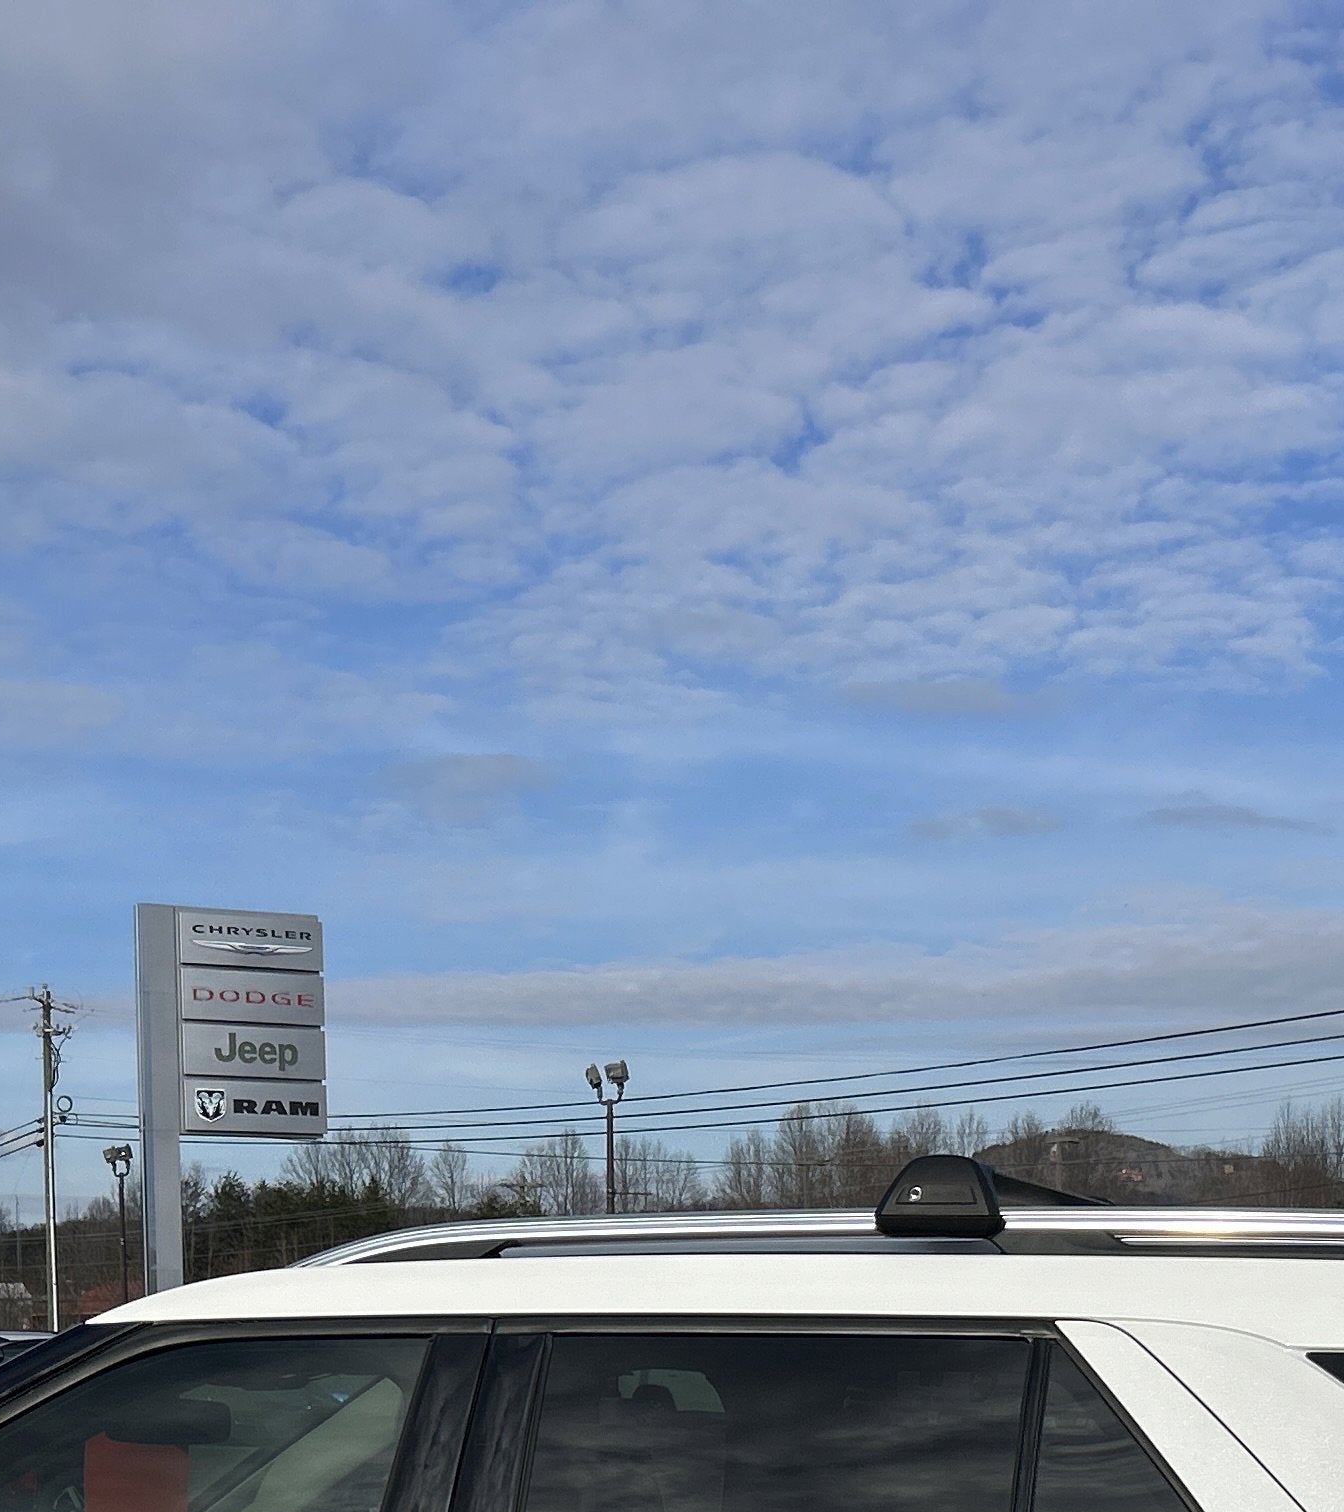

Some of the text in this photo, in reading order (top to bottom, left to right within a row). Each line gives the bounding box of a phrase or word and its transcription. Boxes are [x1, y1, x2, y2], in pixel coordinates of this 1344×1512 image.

[192, 924, 312, 941] CHRYSLER
[192, 988, 315, 1008] DODGE
[214, 1032, 298, 1071] Jeep
[233, 1099, 320, 1117] RAM
